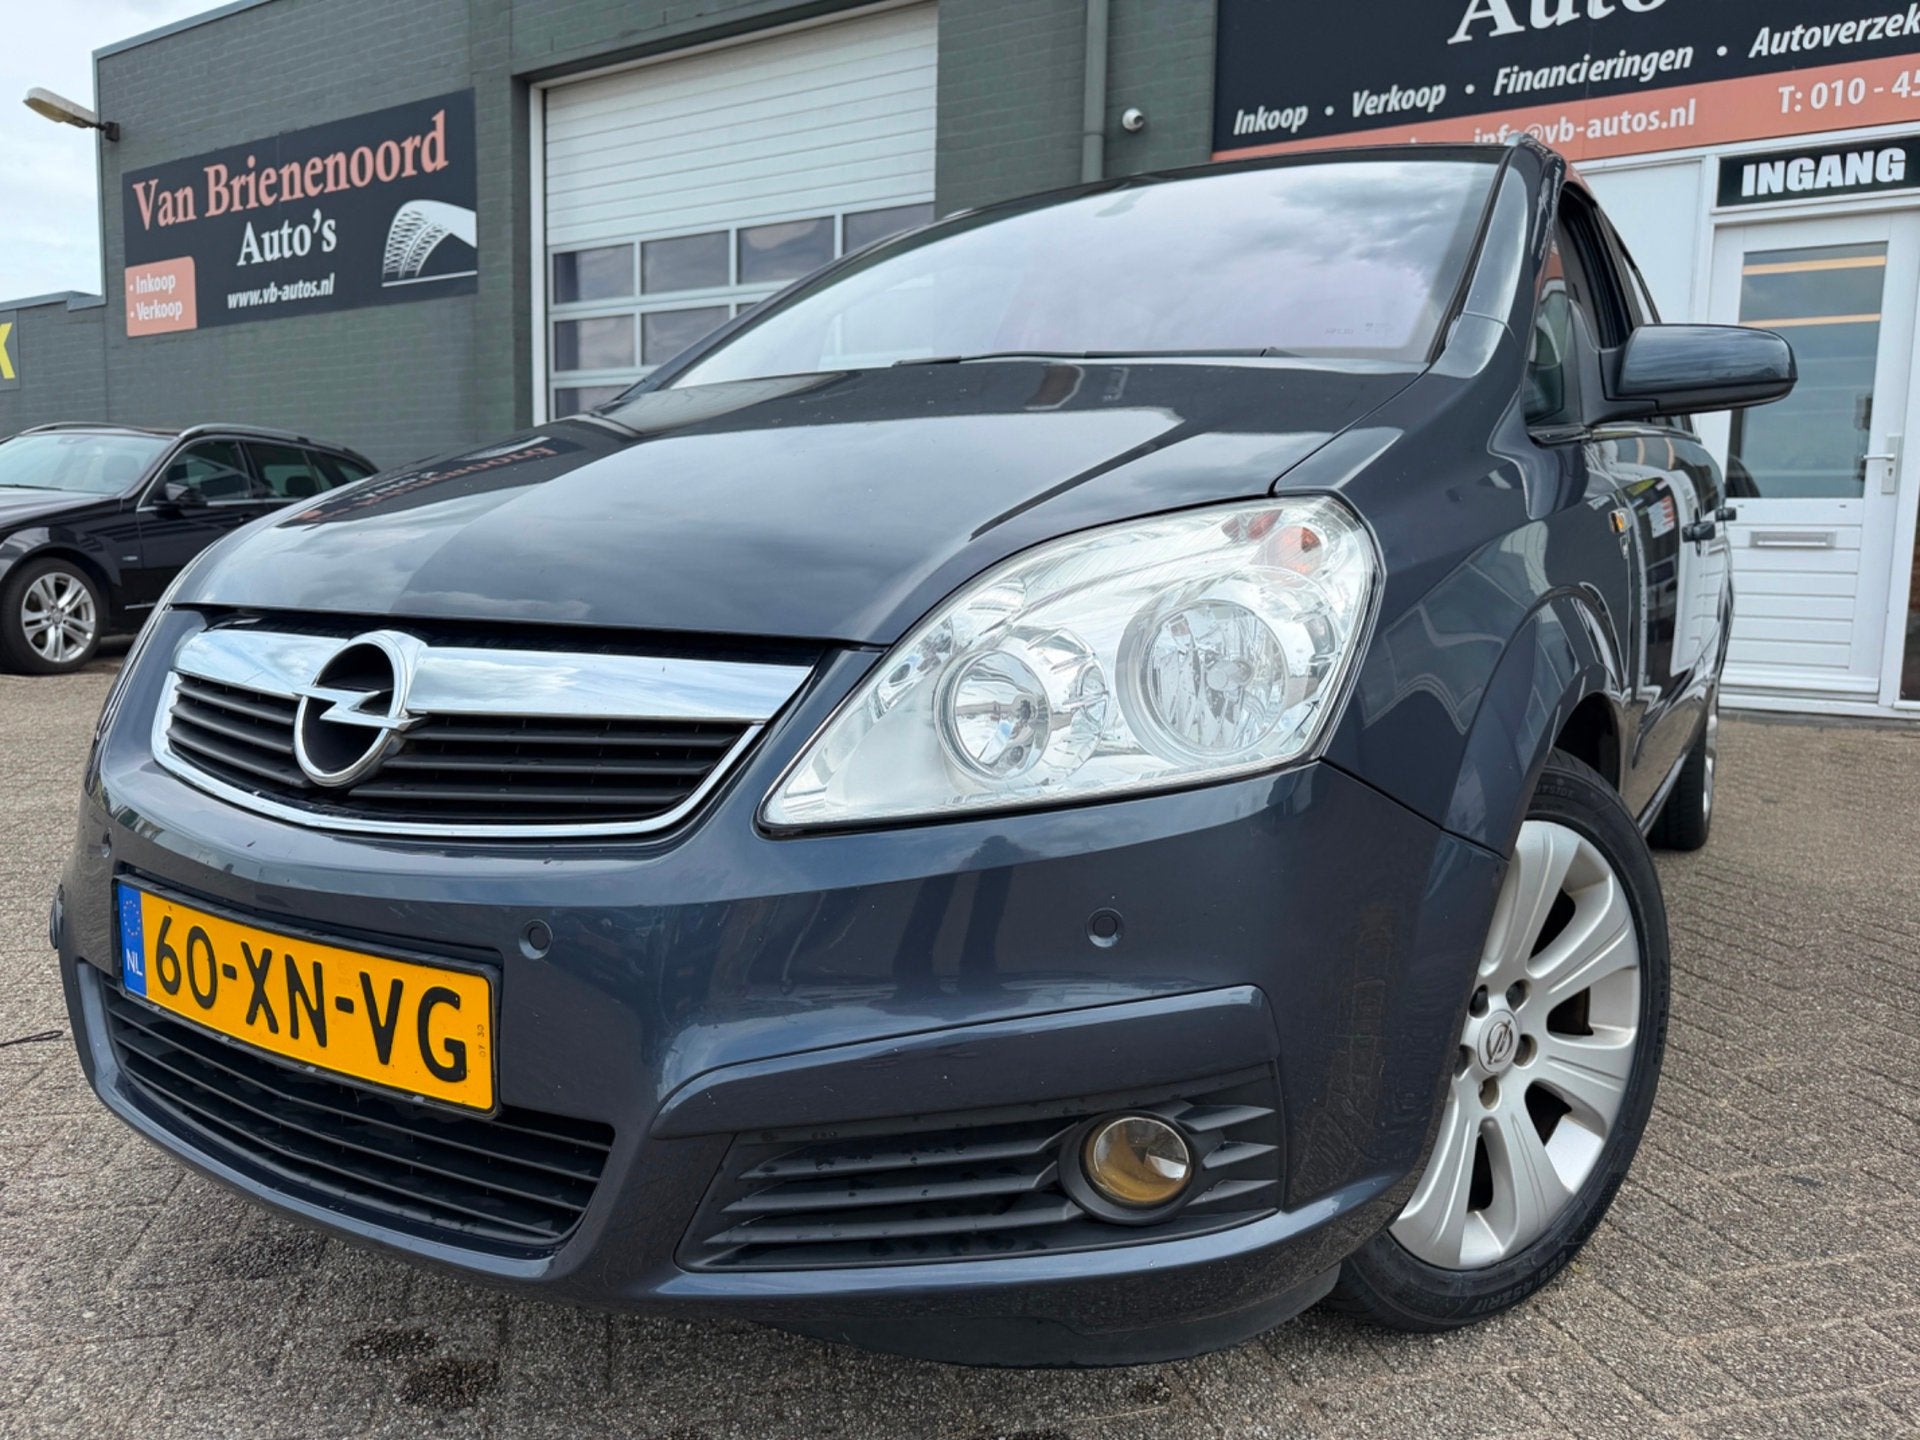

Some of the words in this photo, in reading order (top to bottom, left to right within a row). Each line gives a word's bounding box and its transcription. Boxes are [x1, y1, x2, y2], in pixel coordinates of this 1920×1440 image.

[1233, 101, 1308, 136] Inkoop
[1351, 82, 1446, 118] Verkoop
[1493, 46, 1694, 96] Financieringen
[1748, 2, 1920, 58] Autoverzek
[1778, 85, 1803, 114] T:
[1810, 77, 1866, 110] 010
[132, 179, 197, 231] Van
[204, 109, 449, 218] Brienenoord
[1741, 147, 1906, 197] INGANG
[236, 208, 338, 267] Auto's
[136, 272, 176, 294] Inkoop
[227, 273, 335, 309] www.vb-autos.nl
[136, 300, 183, 321] Verkoop
[126, 949, 143, 977] NL
[155, 915, 468, 1083] 60-XN-VG
